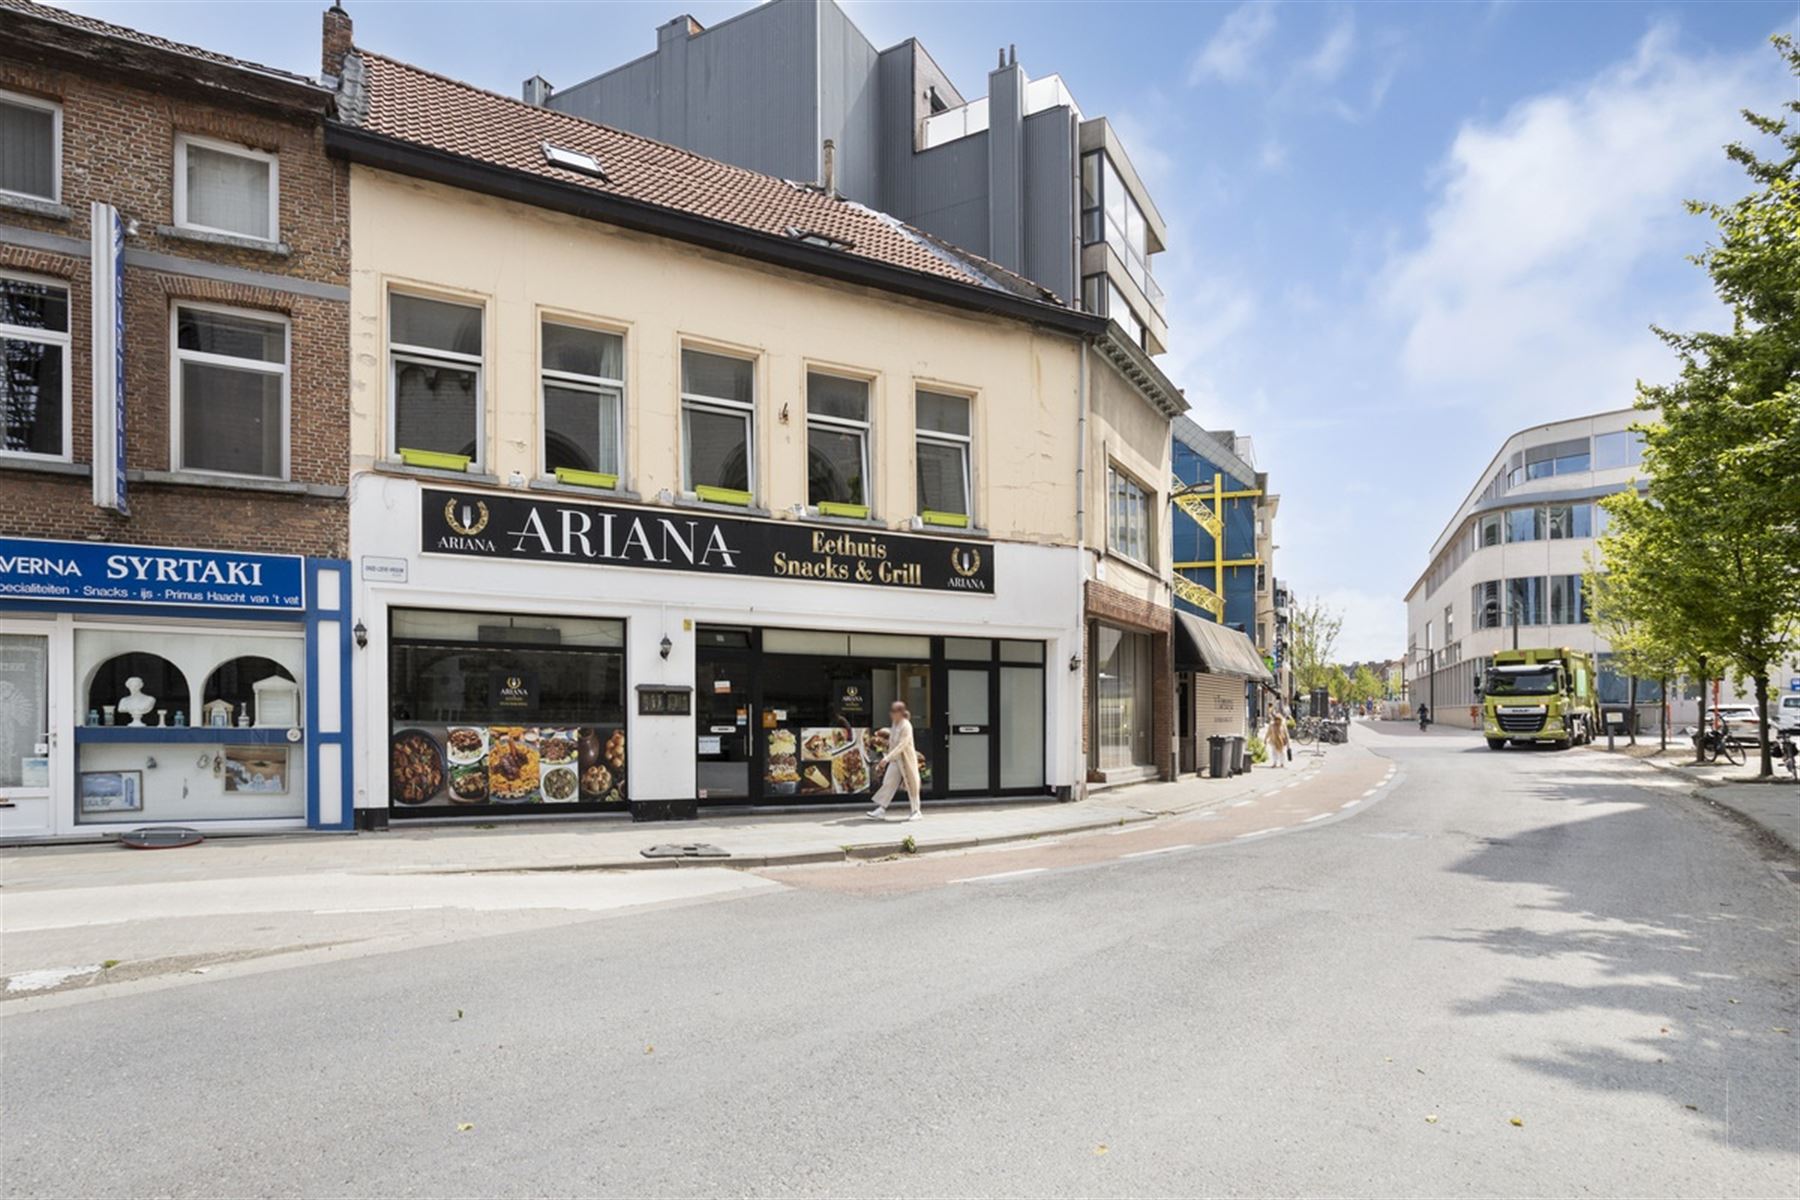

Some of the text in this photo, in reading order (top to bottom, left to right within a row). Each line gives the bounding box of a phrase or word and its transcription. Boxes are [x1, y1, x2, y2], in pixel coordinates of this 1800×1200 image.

[437, 536, 497, 553] ARIANA
[507, 506, 742, 569] ARIANA
[811, 530, 888, 559] Eethuis
[107, 554, 263, 586] SYRTAKI
[773, 551, 922, 586] Snacks & Grill
[947, 576, 986, 590] ARIANA
[83, 585, 129, 598] Snacks
[165, 589, 203, 601] Primus
[207, 591, 246, 603] Haacht
[250, 595, 269, 603] van
[283, 596, 300, 605] vat
